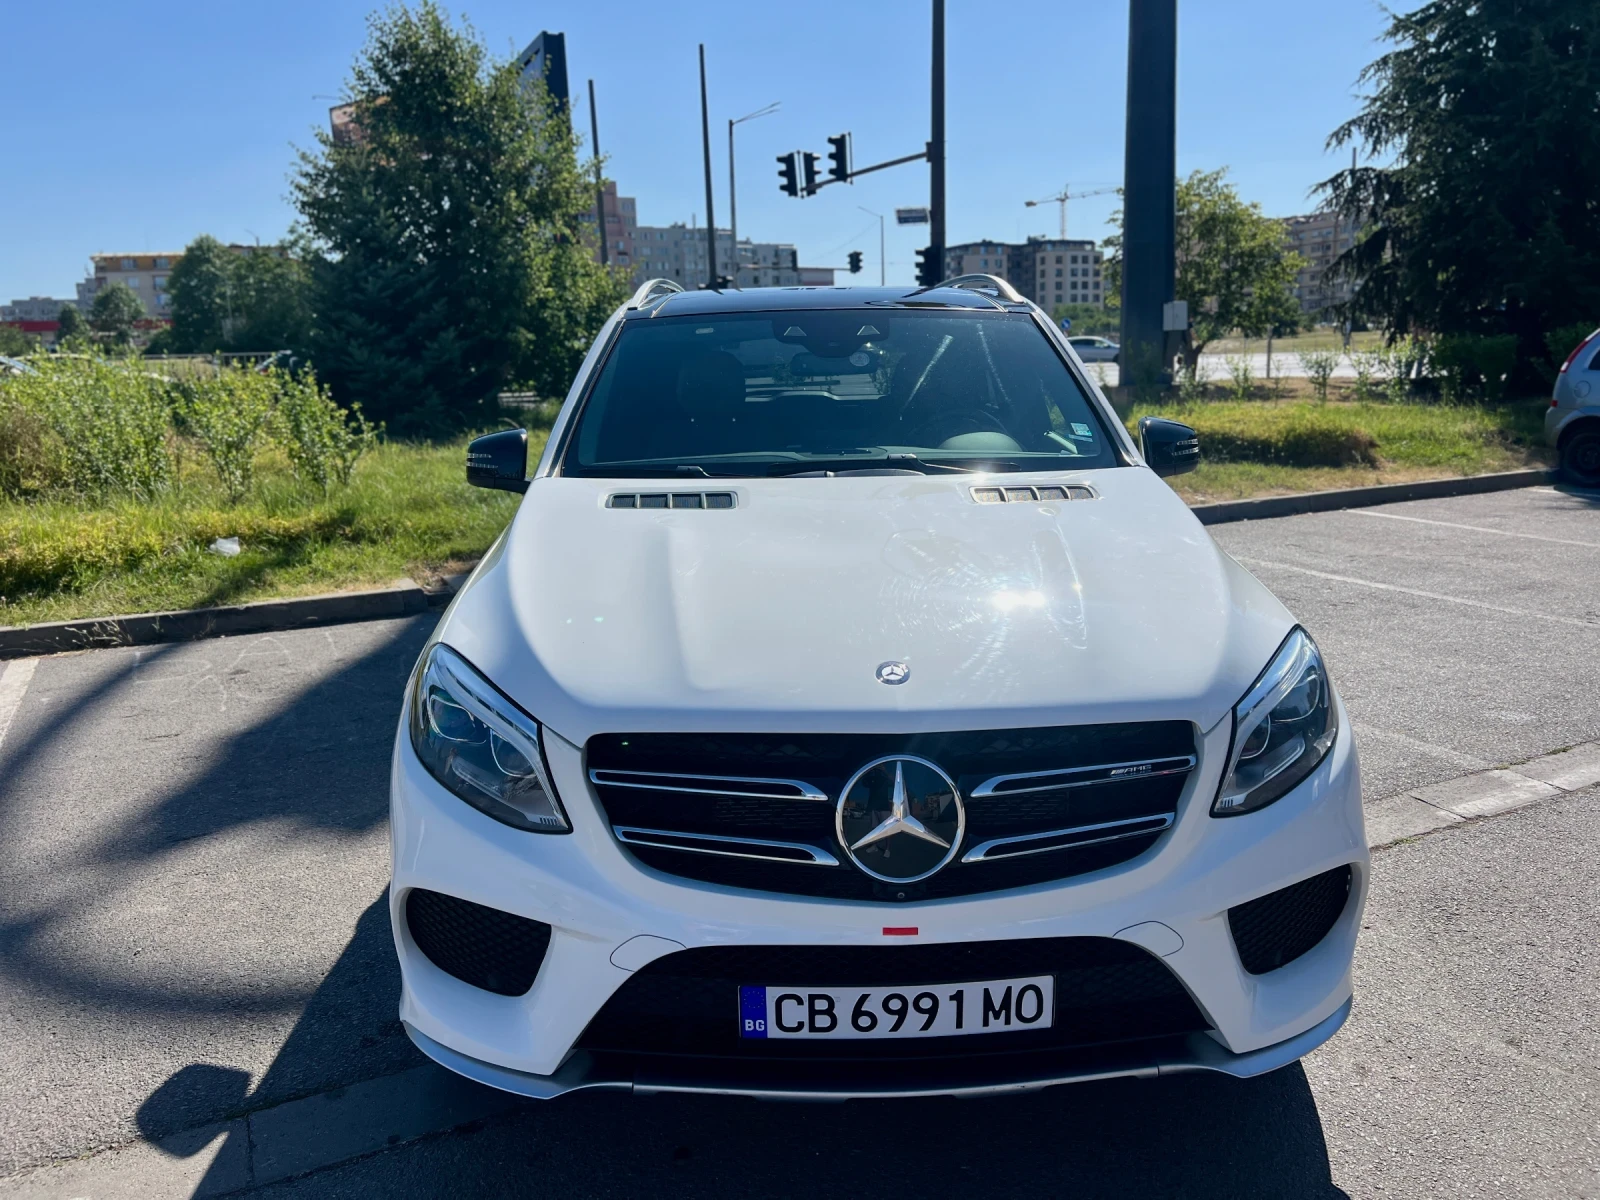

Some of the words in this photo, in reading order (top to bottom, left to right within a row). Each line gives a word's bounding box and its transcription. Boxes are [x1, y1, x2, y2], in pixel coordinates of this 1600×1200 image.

[774, 993, 838, 1033] CB
[851, 989, 965, 1033] 6991
[982, 983, 1044, 1028] MO
[744, 1019, 765, 1031] BG
